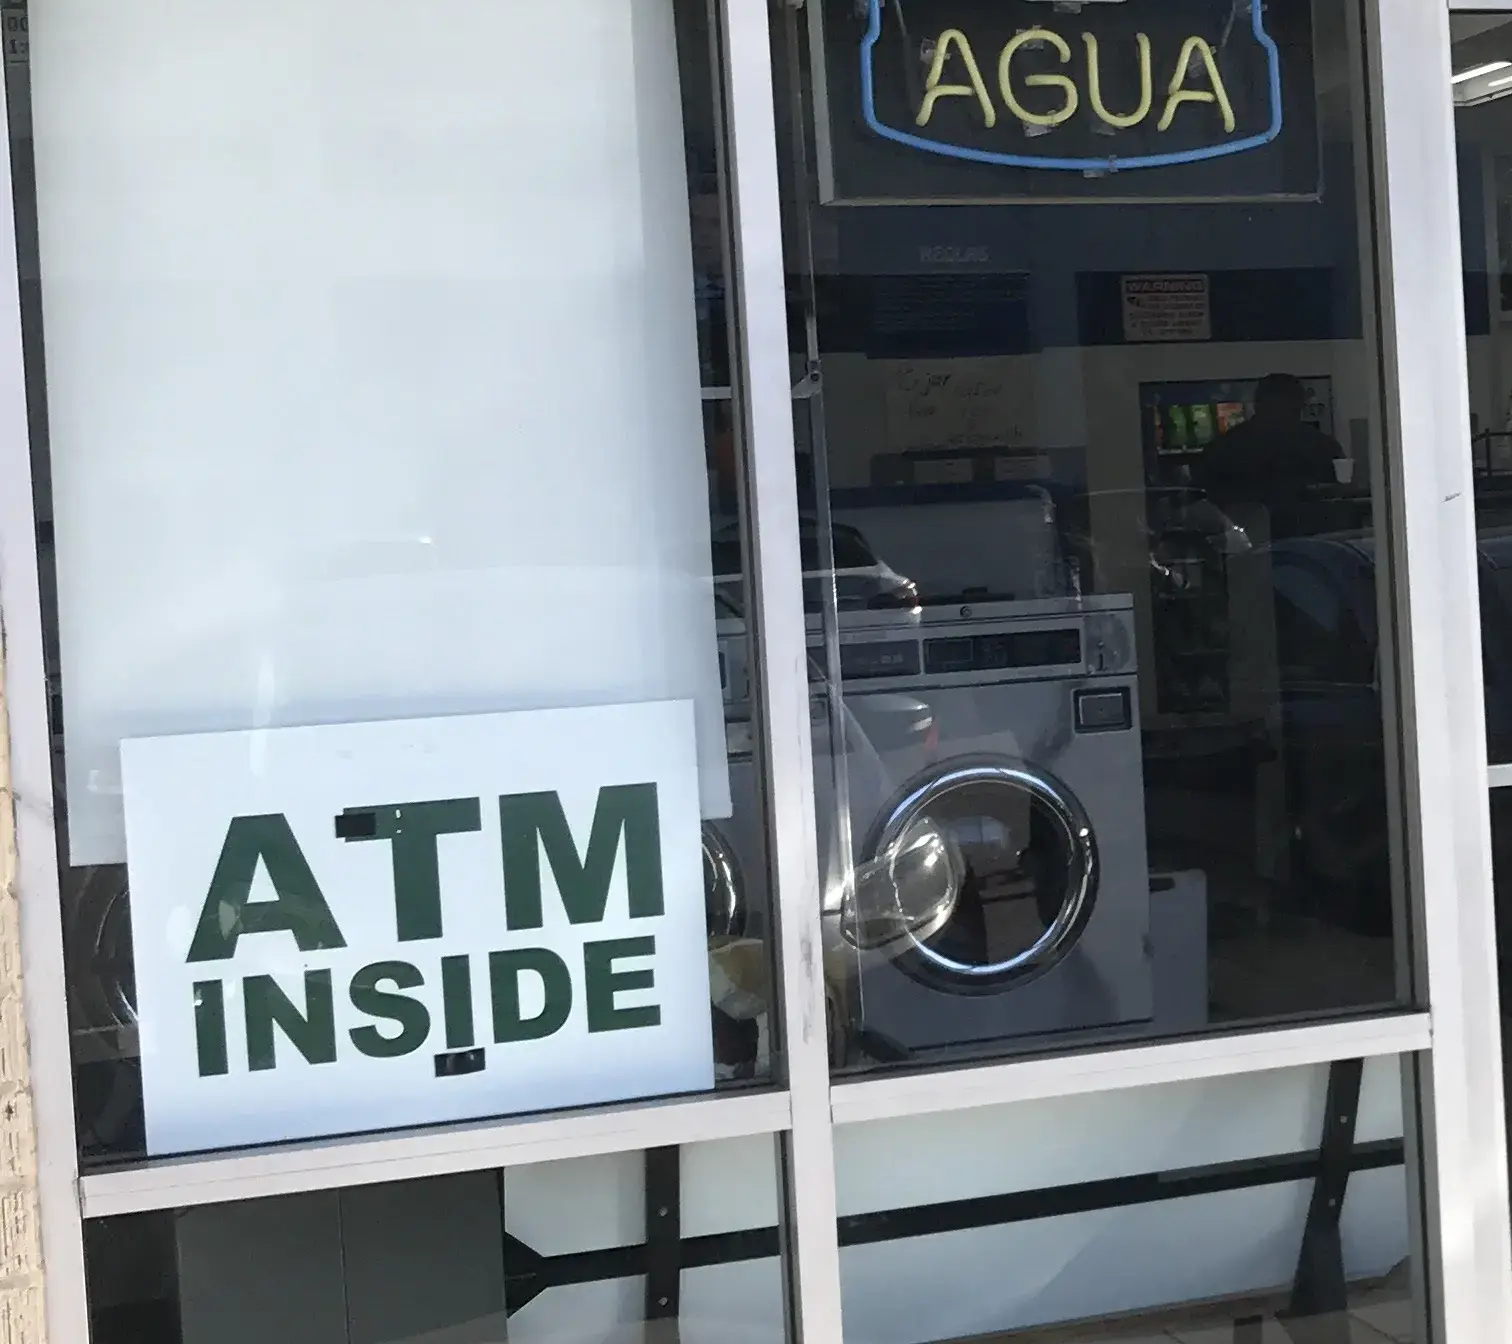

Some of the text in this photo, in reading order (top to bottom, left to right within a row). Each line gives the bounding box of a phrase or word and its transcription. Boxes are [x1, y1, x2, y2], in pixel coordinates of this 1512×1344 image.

[916, 29, 1236, 134] AGUA
[185, 782, 665, 963] ATM
[192, 935, 662, 1078] INSIDE
